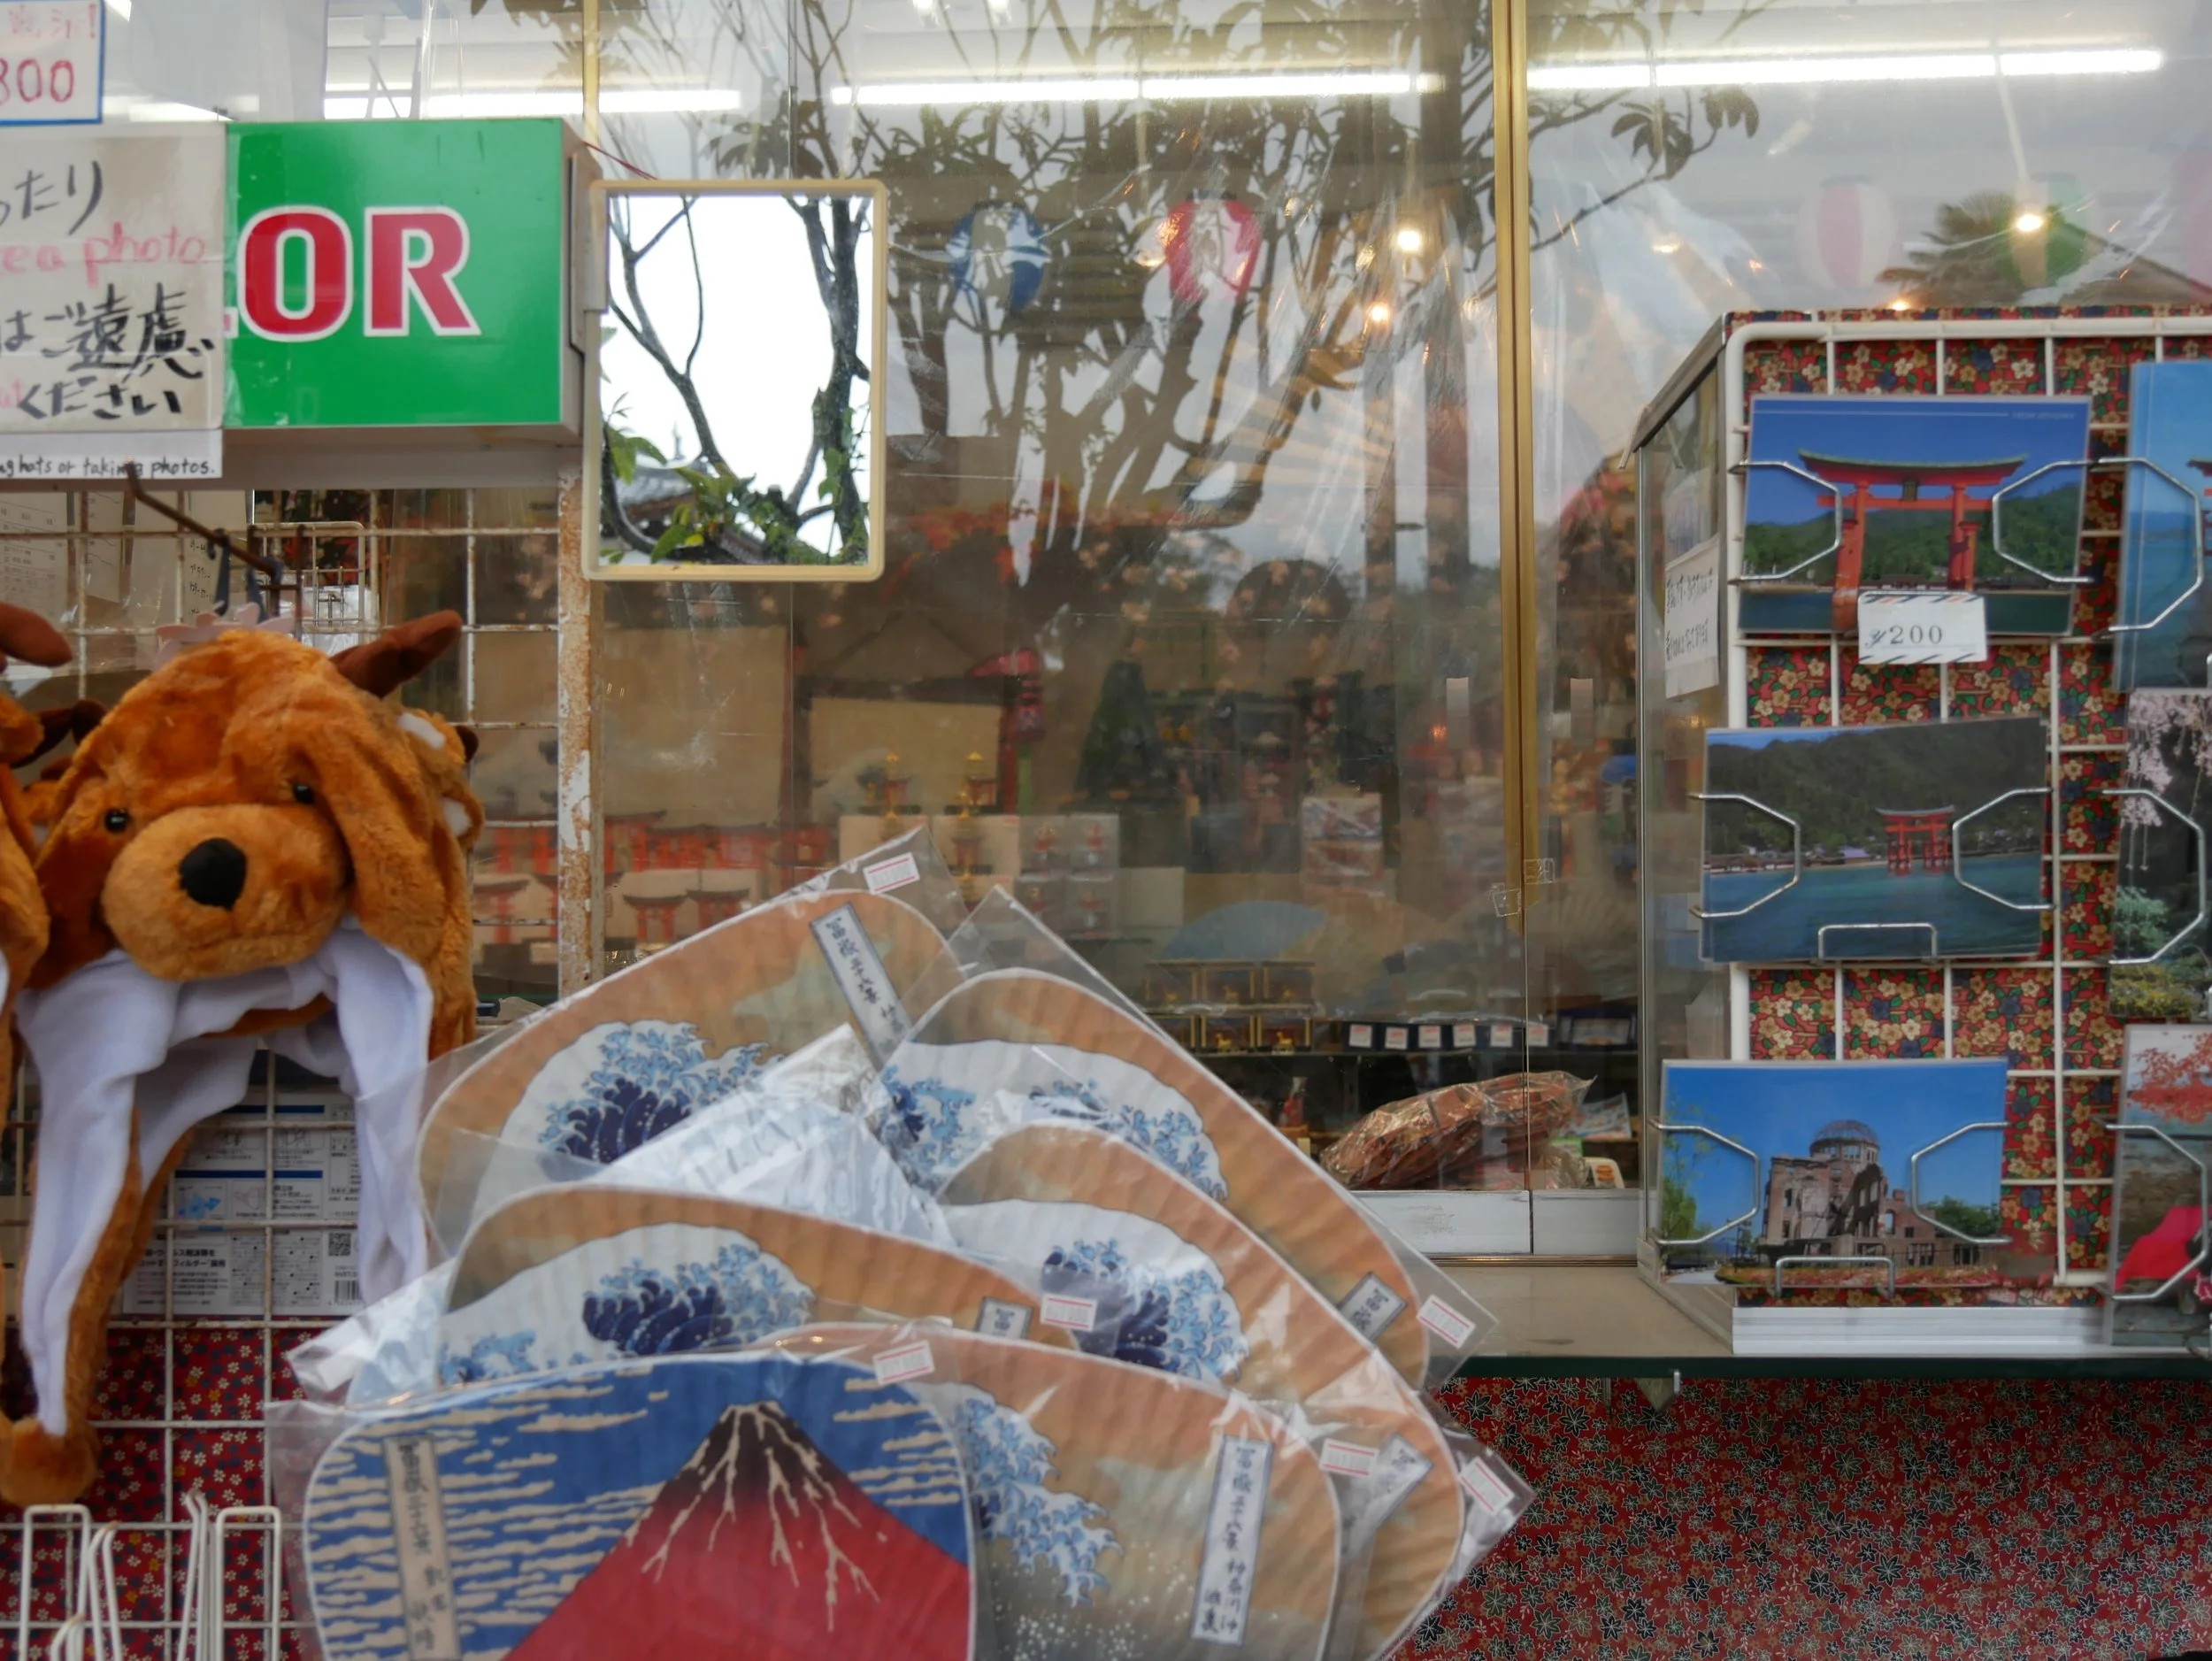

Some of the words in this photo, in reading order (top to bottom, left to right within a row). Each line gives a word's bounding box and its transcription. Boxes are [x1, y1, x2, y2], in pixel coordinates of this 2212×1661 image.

[223, 205, 480, 342] OR
[17, 375, 182, 420] ください
[19, 454, 52, 474] hats
[58, 460, 75, 474] or
